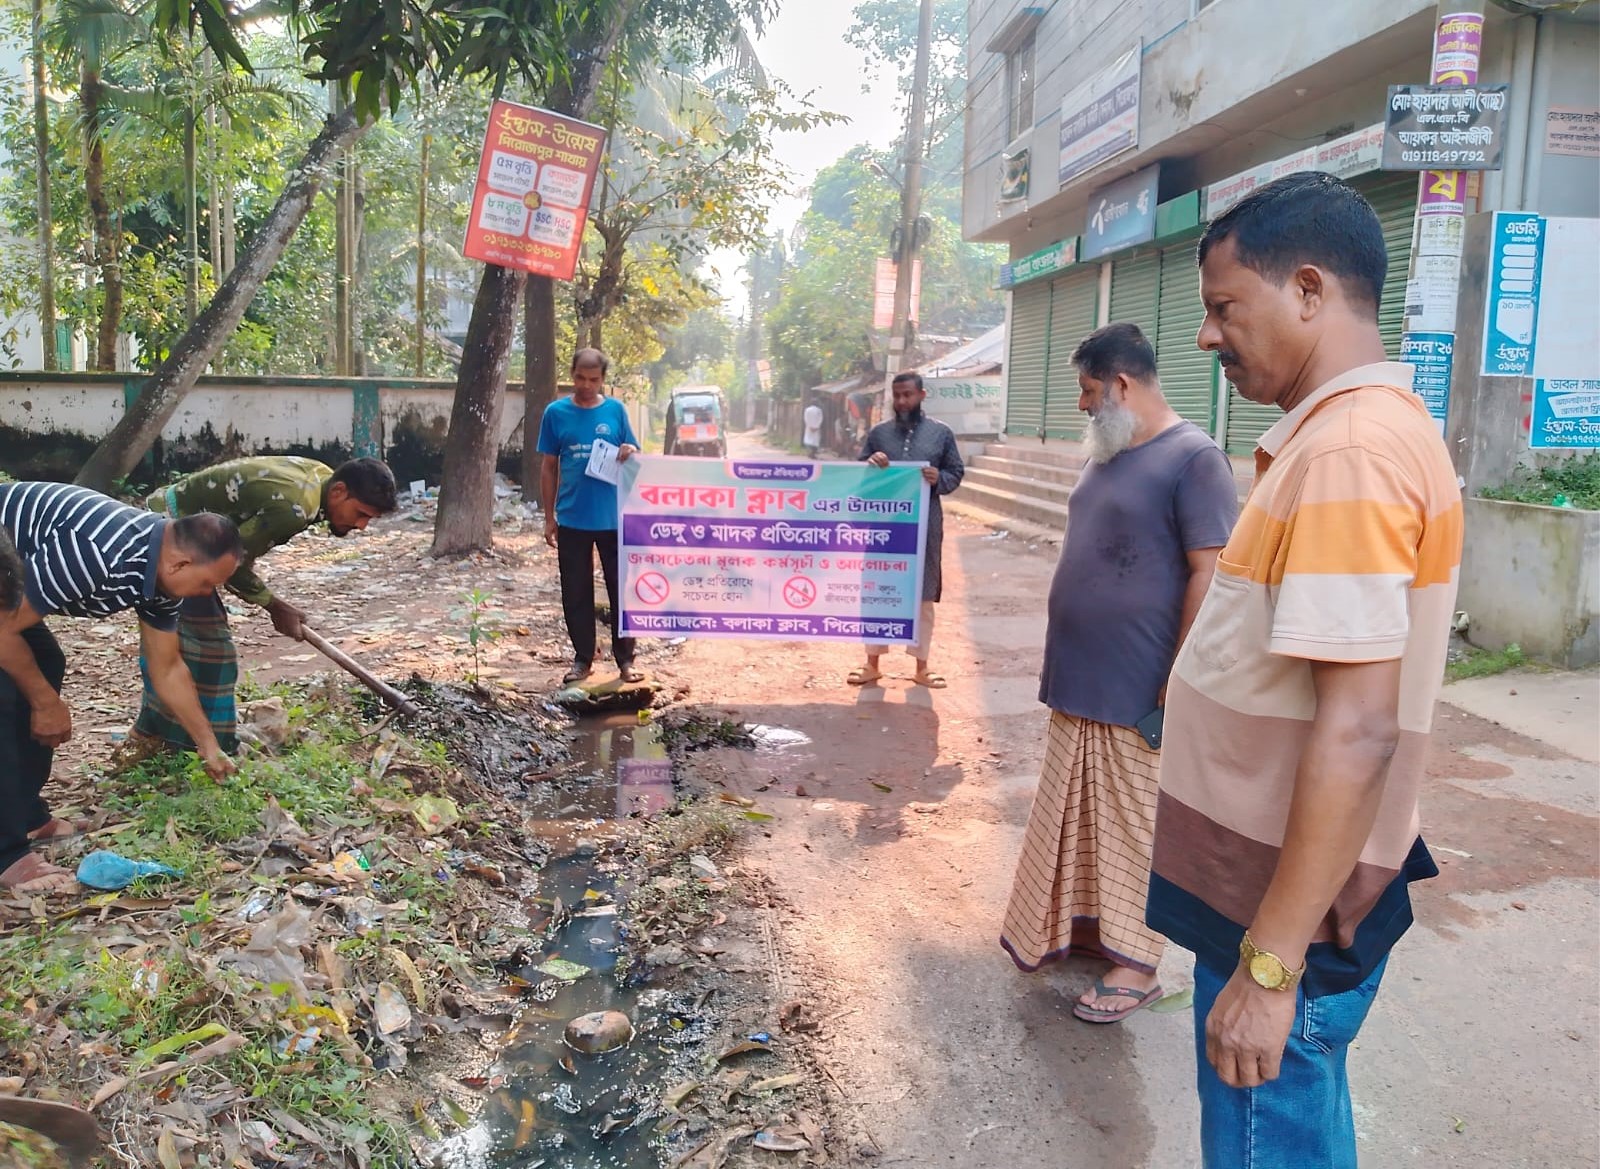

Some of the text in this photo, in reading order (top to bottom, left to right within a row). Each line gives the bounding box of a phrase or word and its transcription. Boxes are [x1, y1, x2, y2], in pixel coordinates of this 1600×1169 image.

[1412, 94, 1450, 112] হায়দার
[1452, 89, 1476, 110] আলী
[1399, 132, 1439, 147] আয়কর
[1440, 126, 1494, 146] আইনজীবী
[498, 133, 588, 169] পিরোজপুর শাখায়
[1401, 151, 1485, 163] 01911849792
[497, 156, 533, 175] ৫ম বৃত্তি
[535, 211, 571, 230] SSC HSC
[638, 484, 913, 514] বলাকা ক্লাব এর উদ্যোগে
[650, 521, 892, 546] ডেঙ্গু ও মাদক প্রতিরোধ বিষয়ক
[717, 554, 757, 571] মূলক
[819, 558, 830, 570] ও
[836, 558, 908, 572] আলোচনা
[682, 591, 718, 601] সচেতন
[722, 617, 774, 632] বলাকা
[822, 616, 906, 638] পিরোজপুর
